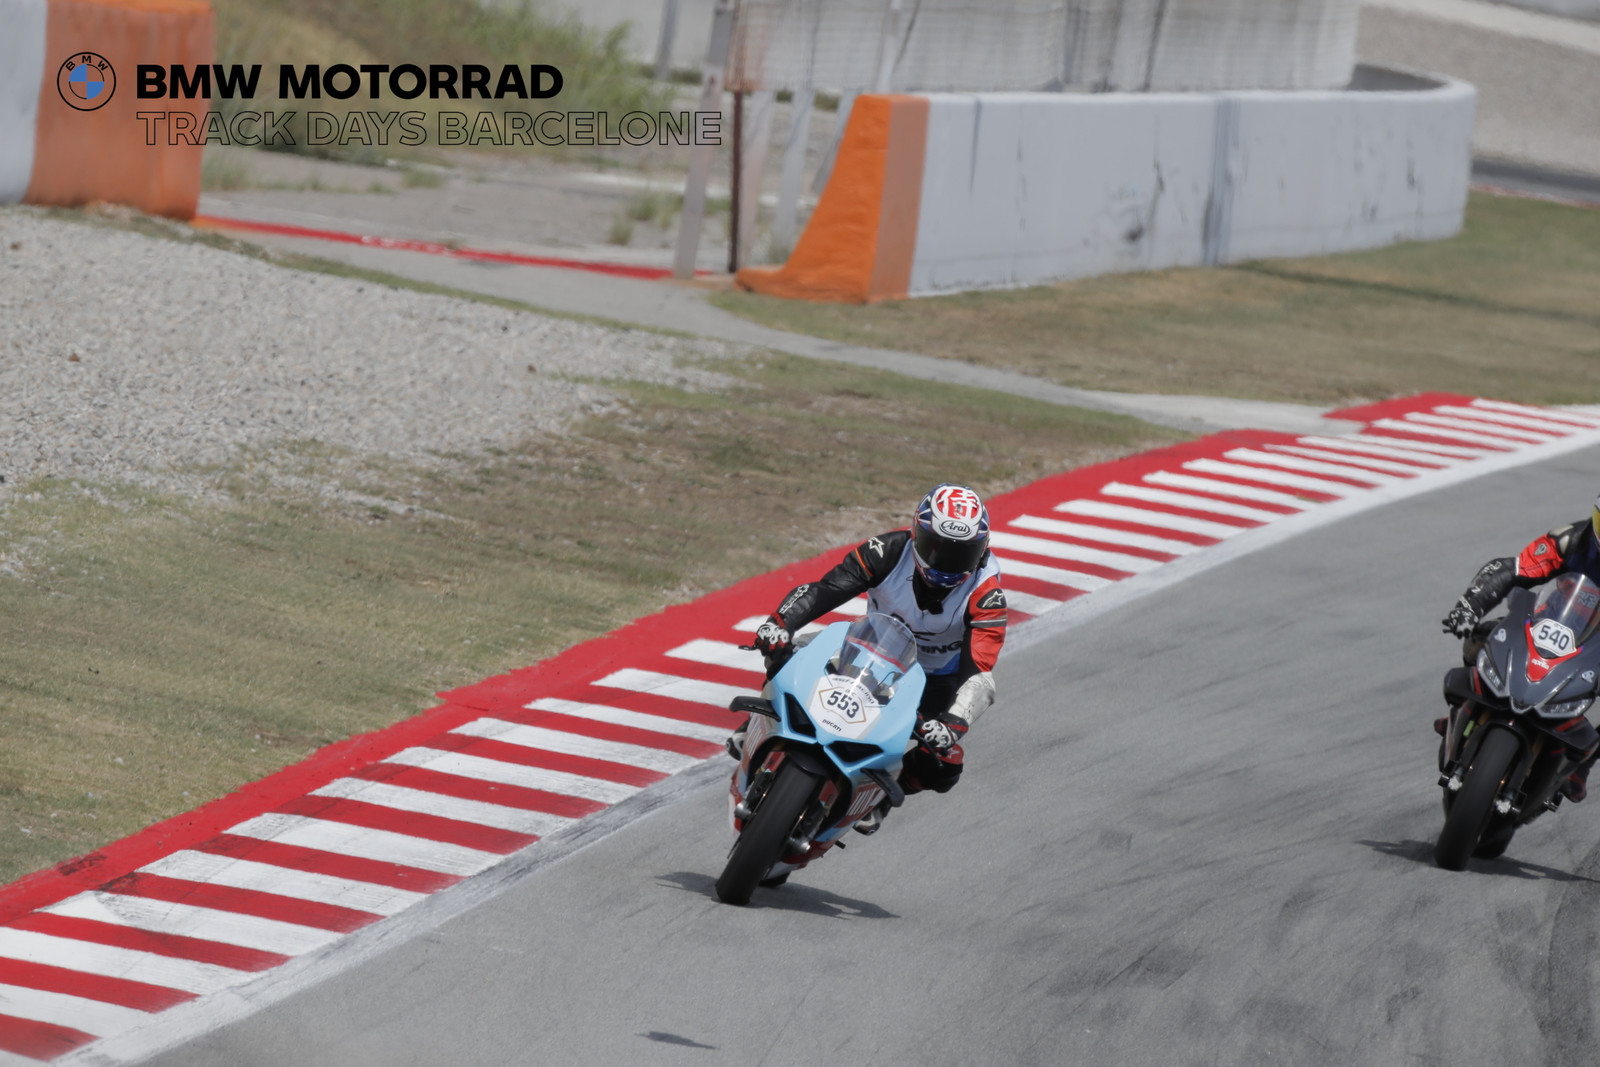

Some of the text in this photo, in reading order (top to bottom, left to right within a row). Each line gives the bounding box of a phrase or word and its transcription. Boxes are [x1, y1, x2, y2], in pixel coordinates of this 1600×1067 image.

[942, 521, 968, 533] Arai
[1538, 625, 1570, 651] 540
[827, 690, 860, 719] 553
[822, 718, 842, 732] DUCATI
